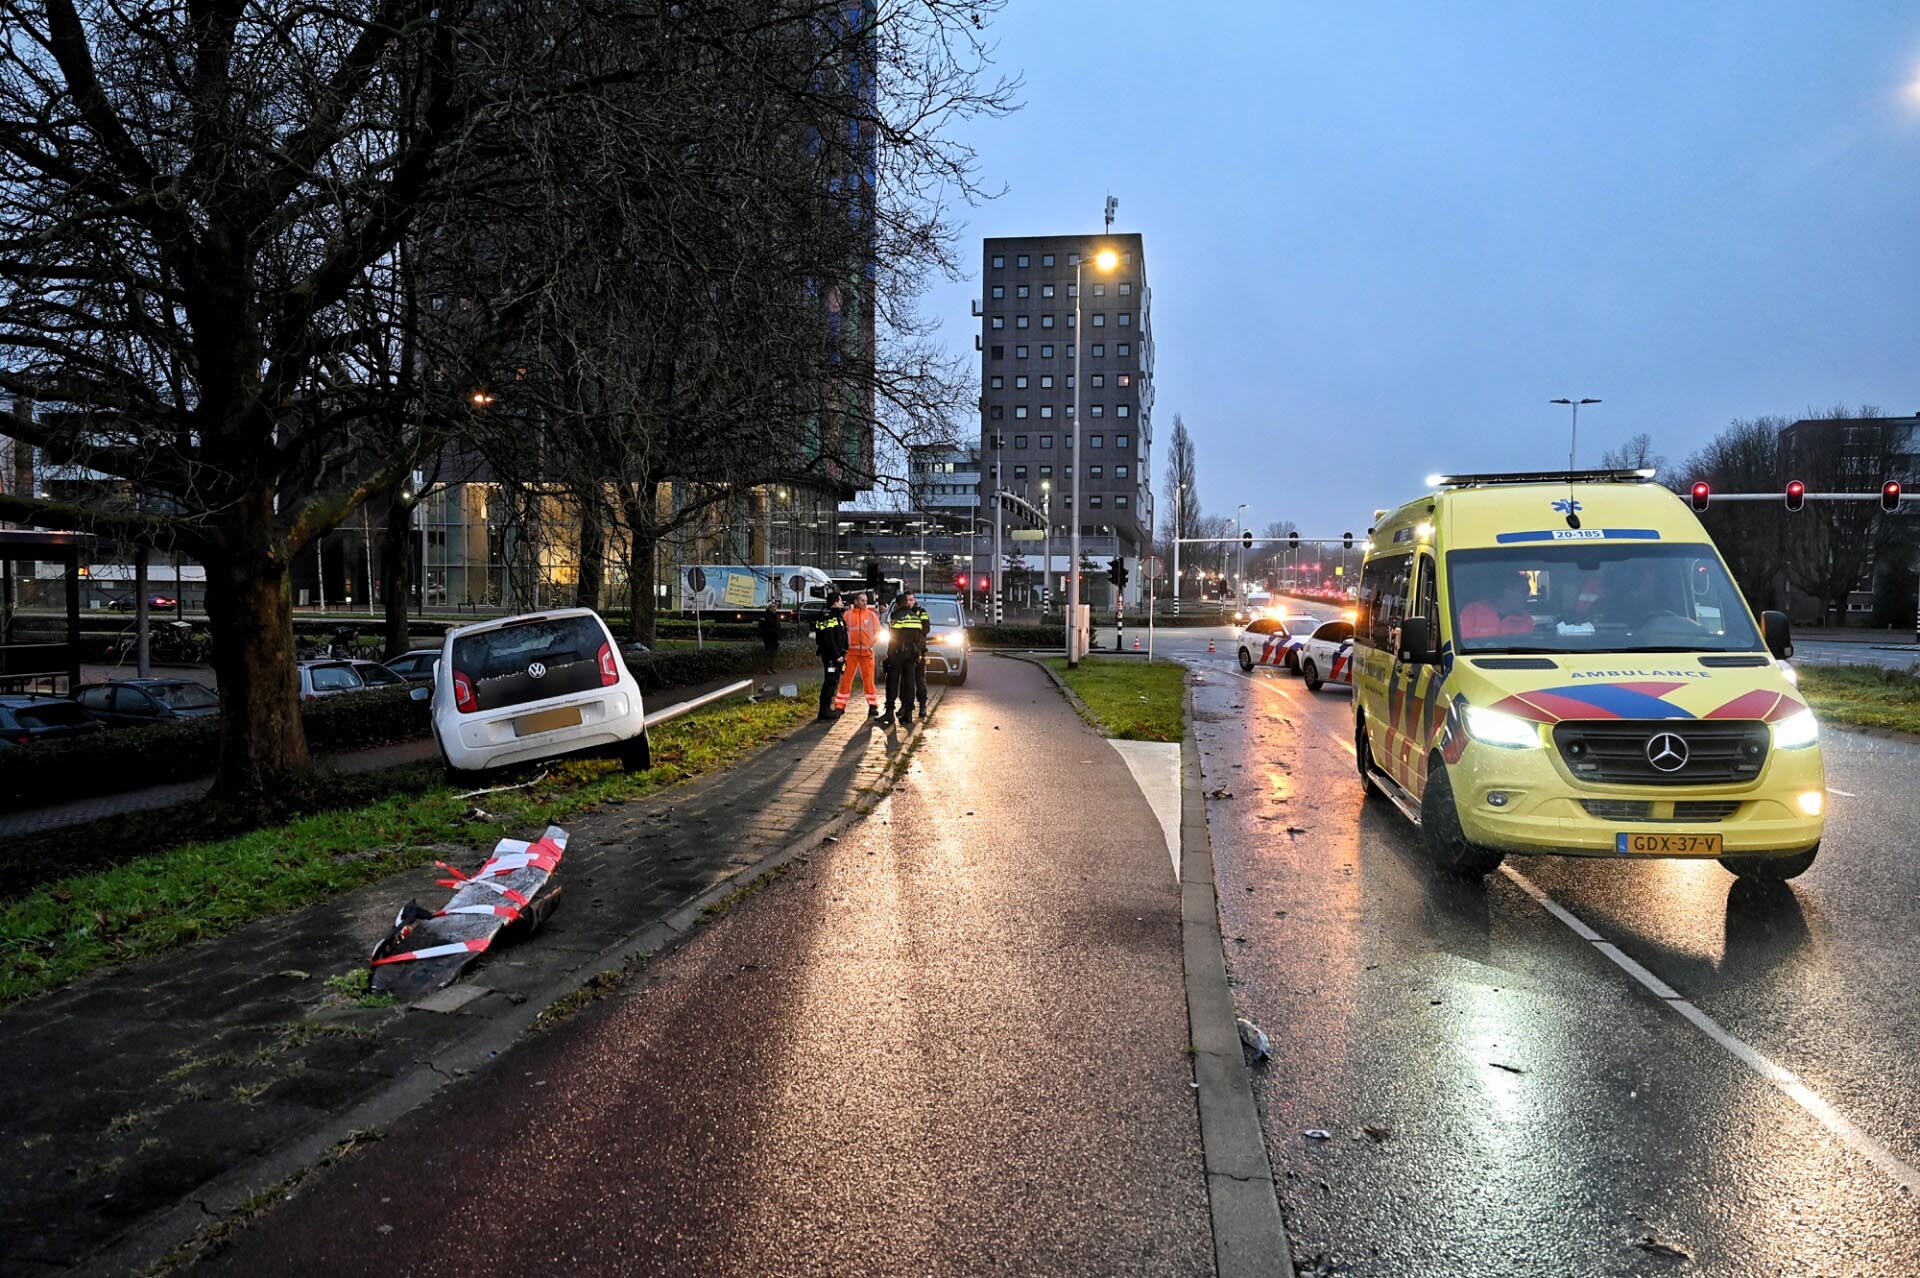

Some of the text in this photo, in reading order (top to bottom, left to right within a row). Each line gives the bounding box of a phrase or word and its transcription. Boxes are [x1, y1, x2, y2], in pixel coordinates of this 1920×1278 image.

[1556, 530, 1600, 538] 20-185
[1571, 670, 1713, 679] AMBULANCE
[1634, 836, 1715, 852] GDX-37-V
